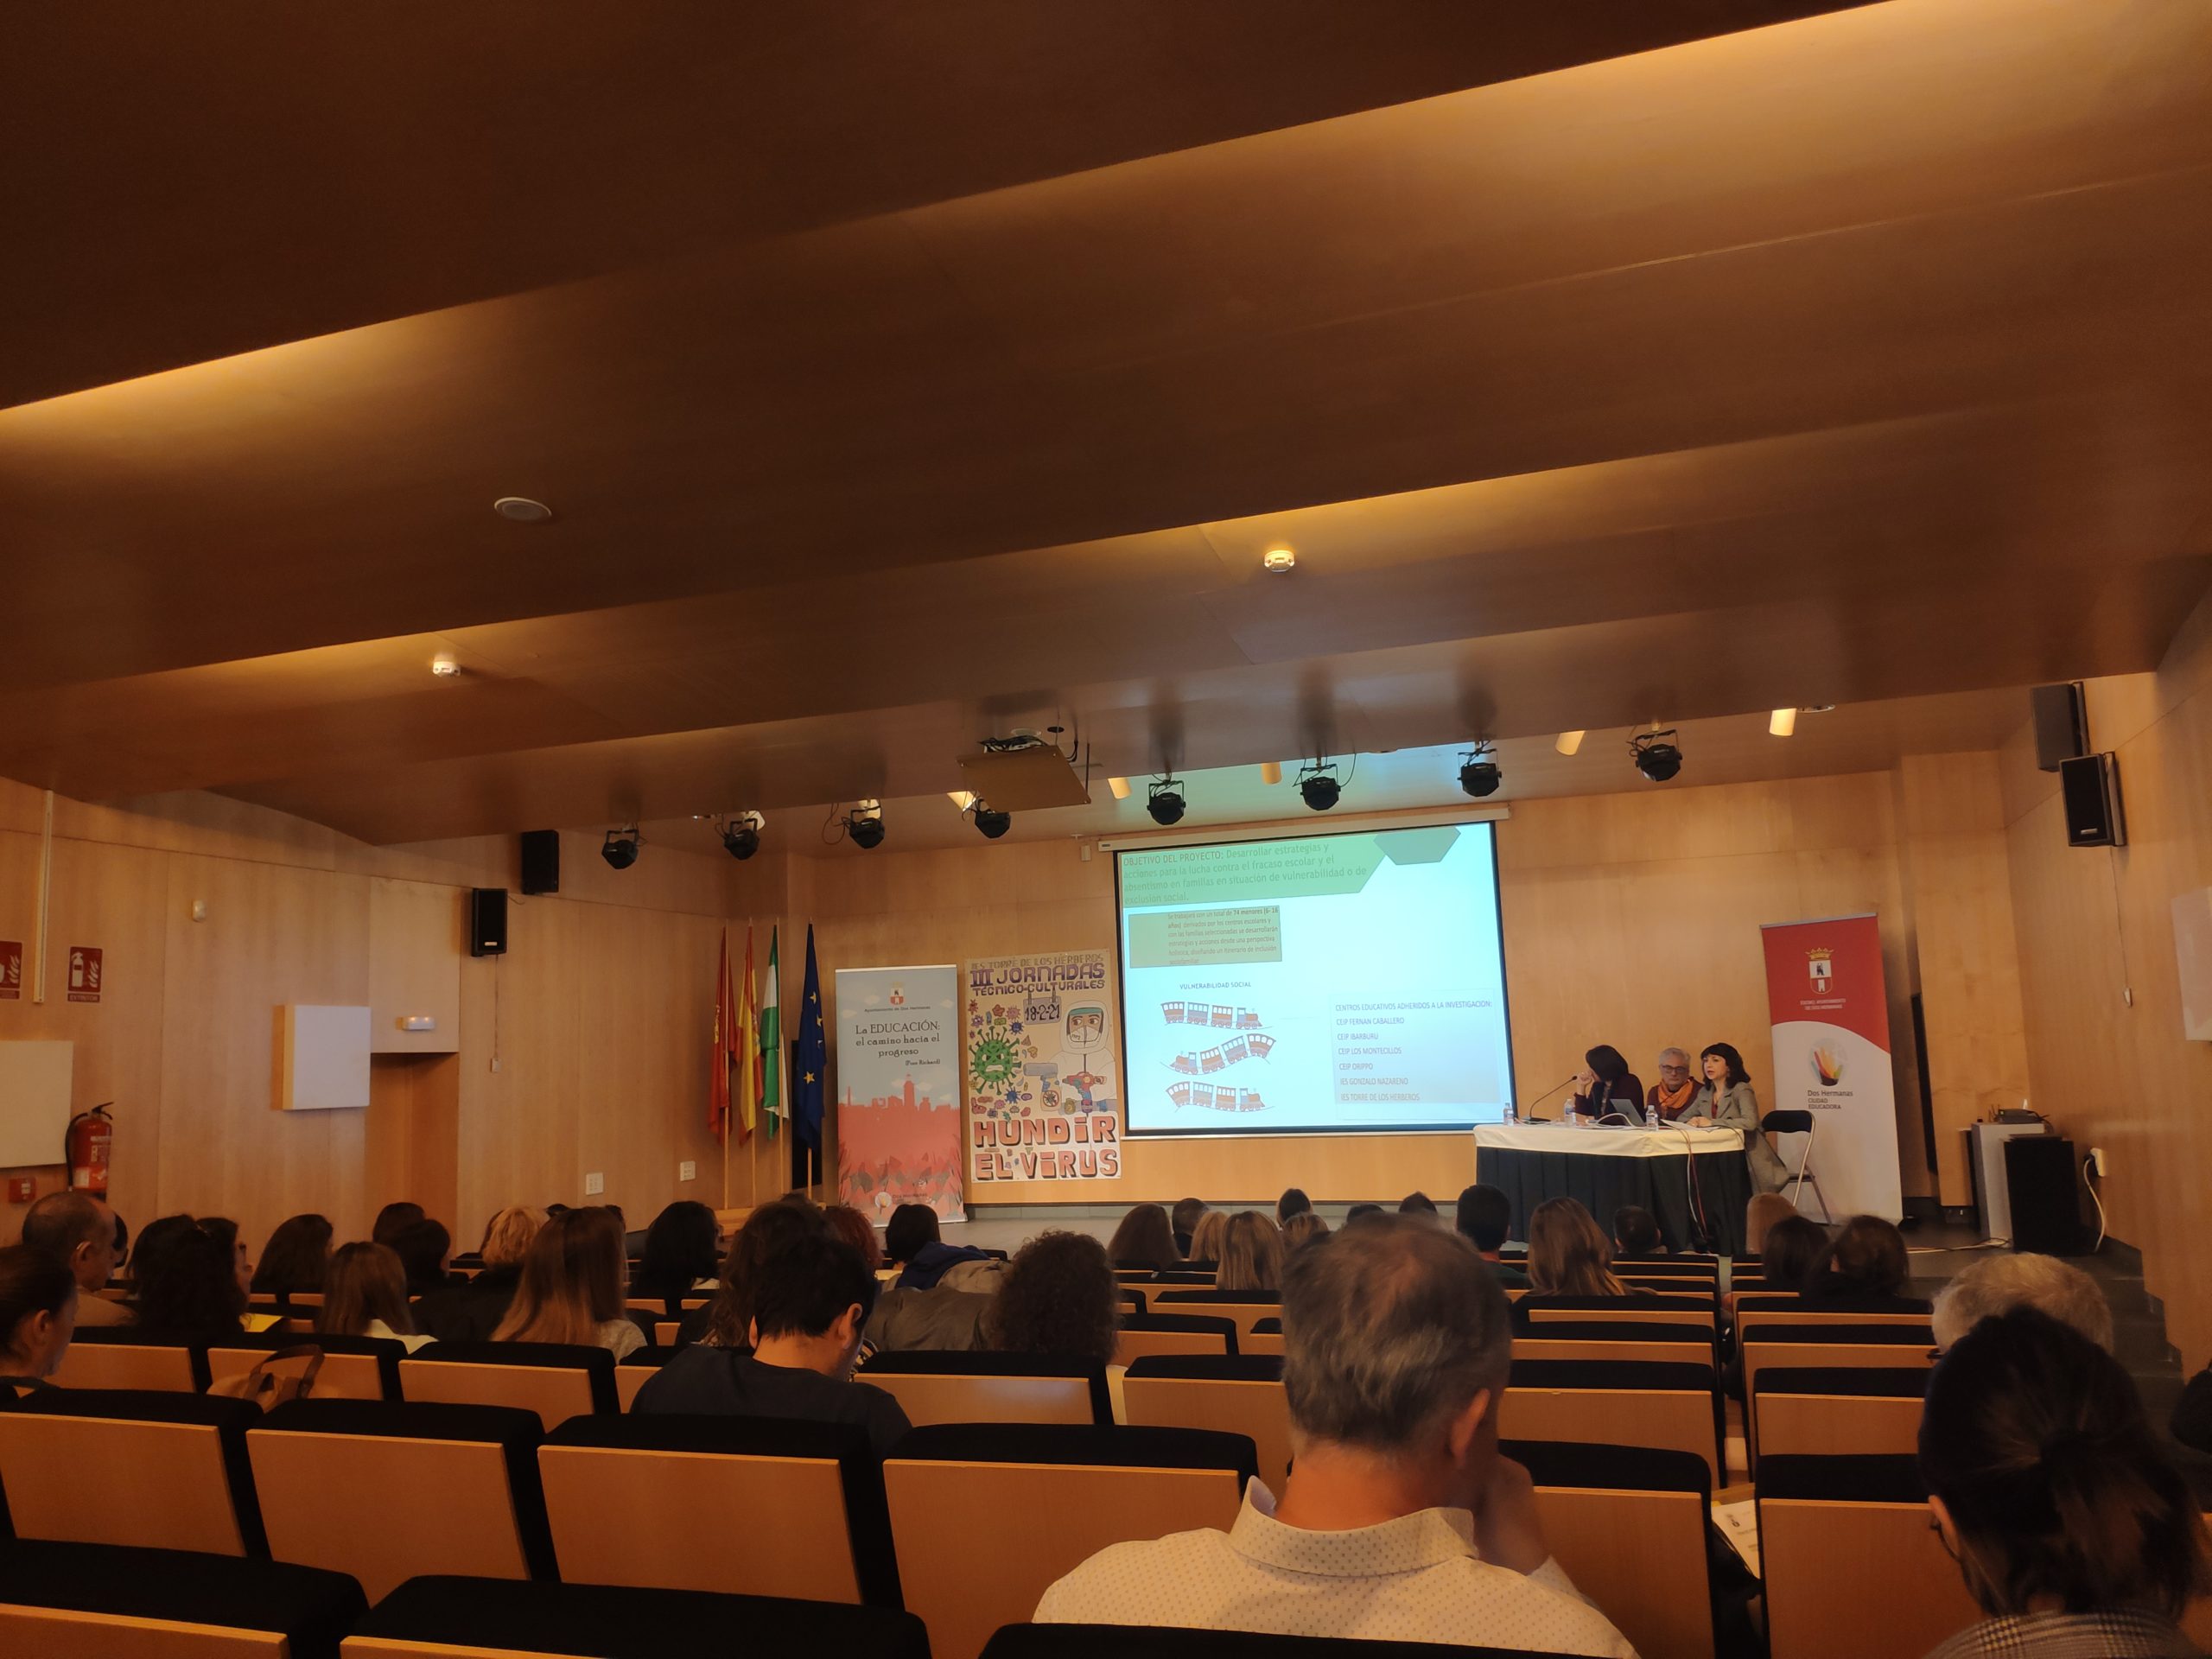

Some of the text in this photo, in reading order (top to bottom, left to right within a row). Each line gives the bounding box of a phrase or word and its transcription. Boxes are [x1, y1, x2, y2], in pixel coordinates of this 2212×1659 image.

[1124, 844, 1328, 866] OBJETIVO DEL PROYECTO: Desarrollar estrategias y
[1124, 855, 1334, 878] acciones para la lucha contra el fracaso escolar y el
[1124, 881, 1168, 892] absentismo
[1183, 877, 1213, 887] familias
[1269, 873, 1280, 881] de
[1282, 868, 1344, 880] vulnerabilidad
[1356, 866, 1367, 875] de
[1164, 892, 1189, 901] social.
[1020, 958, 1033, 967] DE
[1034, 957, 1052, 966] LOS
[970, 963, 1104, 988] III JORNADAS
[855, 1020, 940, 1034] La EDUCACIÓN:
[856, 1037, 864, 1046] el
[904, 1034, 929, 1044] hacia
[931, 1033, 939, 1042] el
[878, 1049, 918, 1058] progreso
[975, 1153, 1013, 1180] EL
